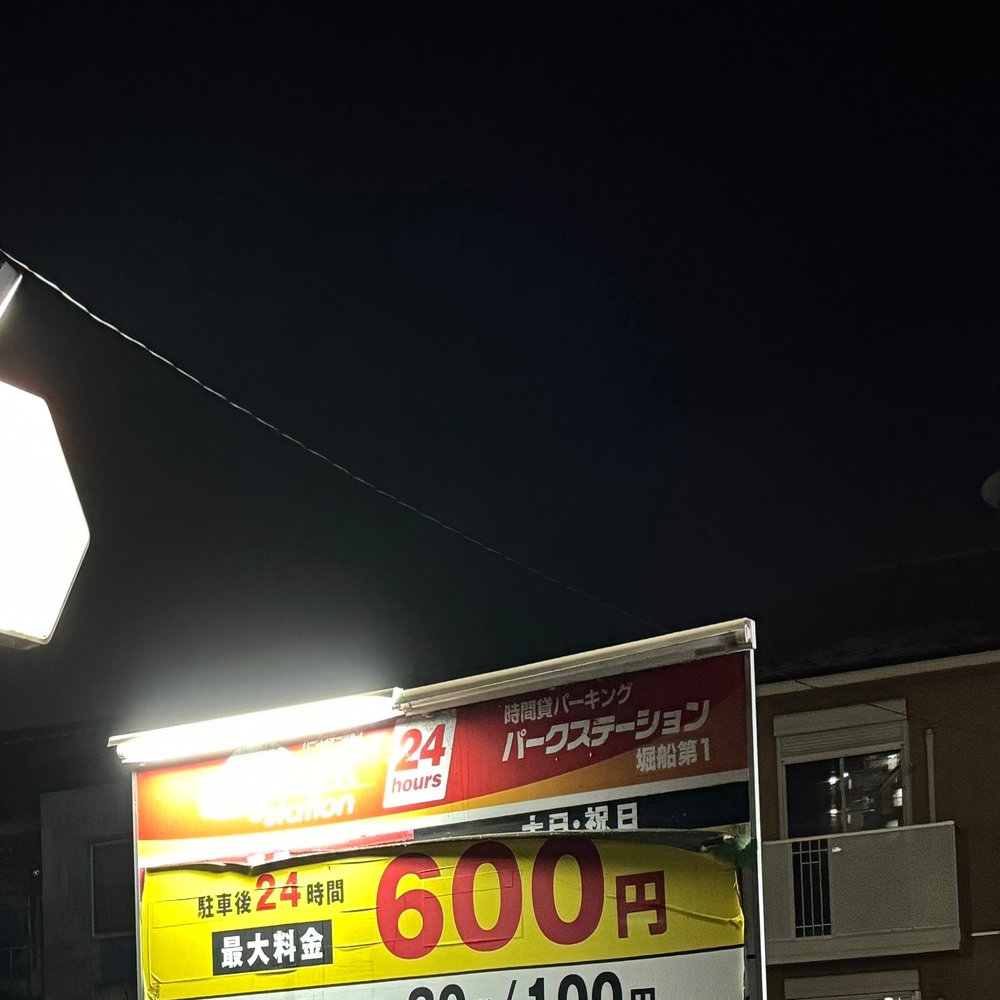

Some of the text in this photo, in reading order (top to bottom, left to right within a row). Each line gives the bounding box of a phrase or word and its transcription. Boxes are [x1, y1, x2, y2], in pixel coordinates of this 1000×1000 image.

[504, 682, 634, 725] 時間貸パーキング
[396, 723, 445, 772] 24
[502, 700, 710, 762] パークステーション
[635, 737, 711, 773] 堀船第1
[391, 771, 442, 794] hours
[376, 836, 668, 960] 600円
[221, 926, 323, 968] 最大料金
